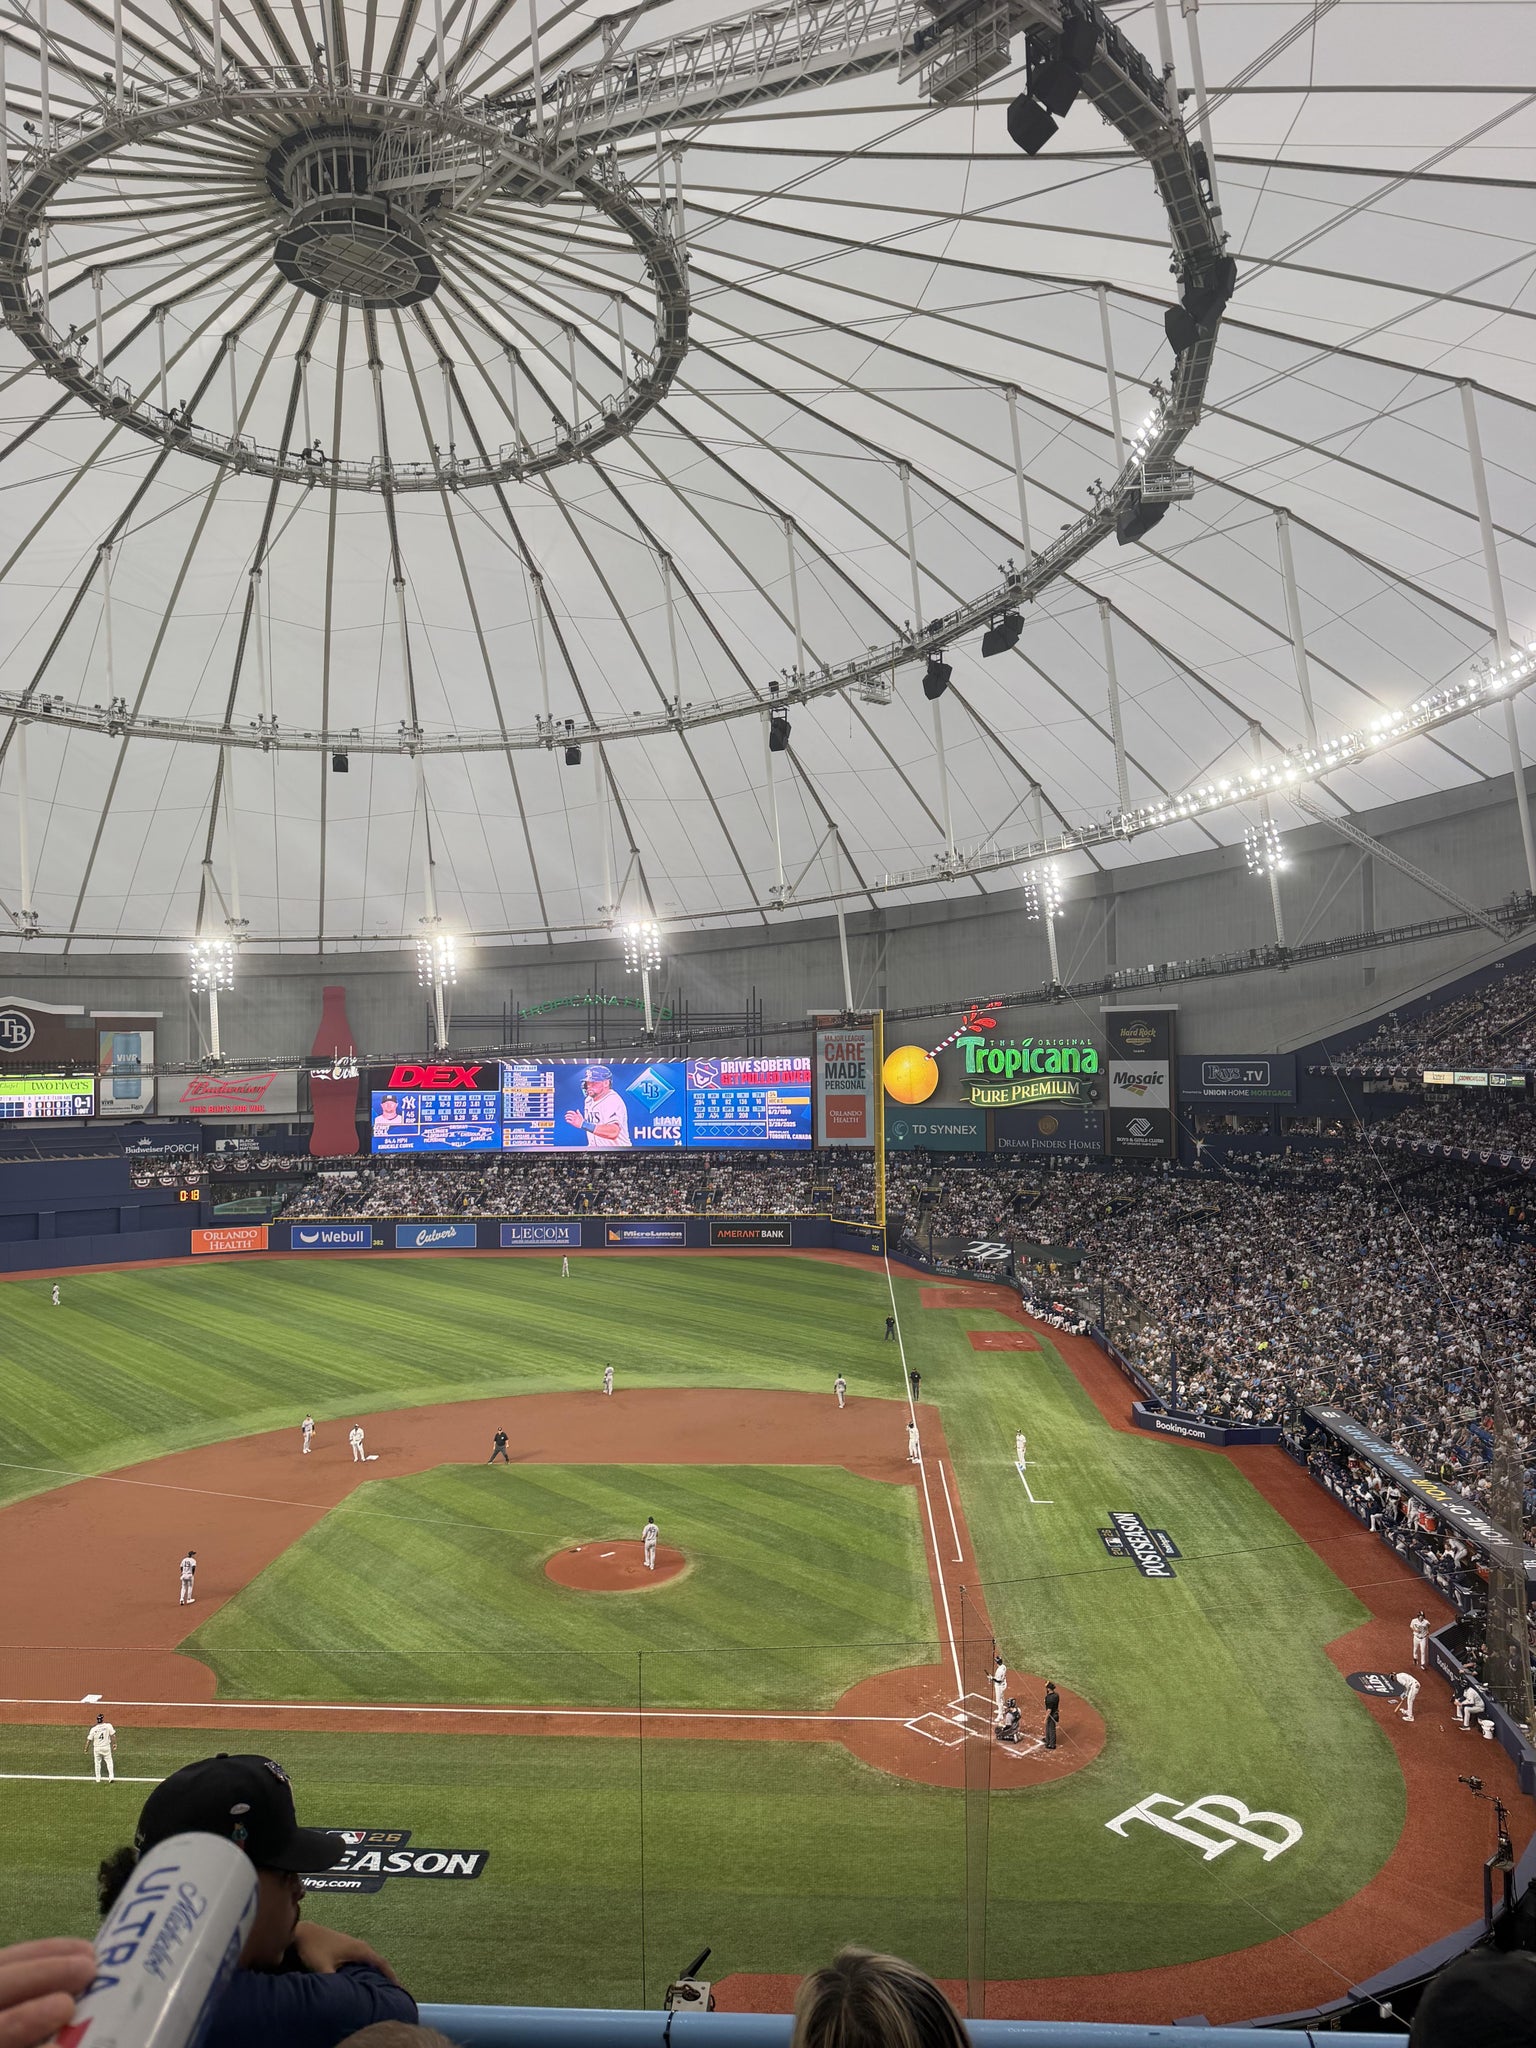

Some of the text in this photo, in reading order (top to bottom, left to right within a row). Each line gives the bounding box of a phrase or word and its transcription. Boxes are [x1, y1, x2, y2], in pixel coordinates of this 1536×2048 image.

[623, 996, 673, 1020] FILD
[1120, 1027, 1157, 1038] Hard Rock
[824, 1043, 865, 1062] CARE
[956, 1036, 1099, 1078] Tropicana
[721, 1058, 811, 1073] DRIVE SOBER OR
[825, 1062, 866, 1079] MADE
[388, 1065, 483, 1089] DEX
[721, 1070, 811, 1086] GET PULLED OVER
[1113, 1071, 1164, 1085] Mosaic
[31, 1081, 53, 1090] two
[55, 1080, 89, 1090] rivers
[825, 1080, 866, 1090] PERSONAL
[971, 1081, 1080, 1103] PURE PREMIUM
[74, 1096, 91, 1108] 0-1
[653, 1116, 682, 1126] LIAM
[634, 1126, 681, 1139] HICKS
[912, 1124, 977, 1135] TD SYNNEX
[125, 1143, 200, 1154] Budweiser PORCH
[998, 1138, 1101, 1150] DREAM FINDERS HOMES
[180, 1189, 200, 1201] 0:18
[203, 1230, 258, 1241] ORLANDO
[321, 1231, 364, 1243] Webull
[415, 1226, 457, 1246] Culver's
[717, 1230, 784, 1238] AMERANT BANK
[210, 1239, 251, 1250] HEALTH
[963, 1240, 1012, 1260] TB
[1156, 1420, 1206, 1438] Booking.com
[1411, 1479, 1453, 1502] YOUR
[1461, 1517, 1513, 1545] HOME
[1113, 1513, 1170, 1576] POSTSEASON
[1105, 1793, 1303, 1862] TB
[329, 1850, 480, 1875] EASON
[304, 1877, 362, 1889] ing.com
[76, 1865, 181, 2005] ULTRA
